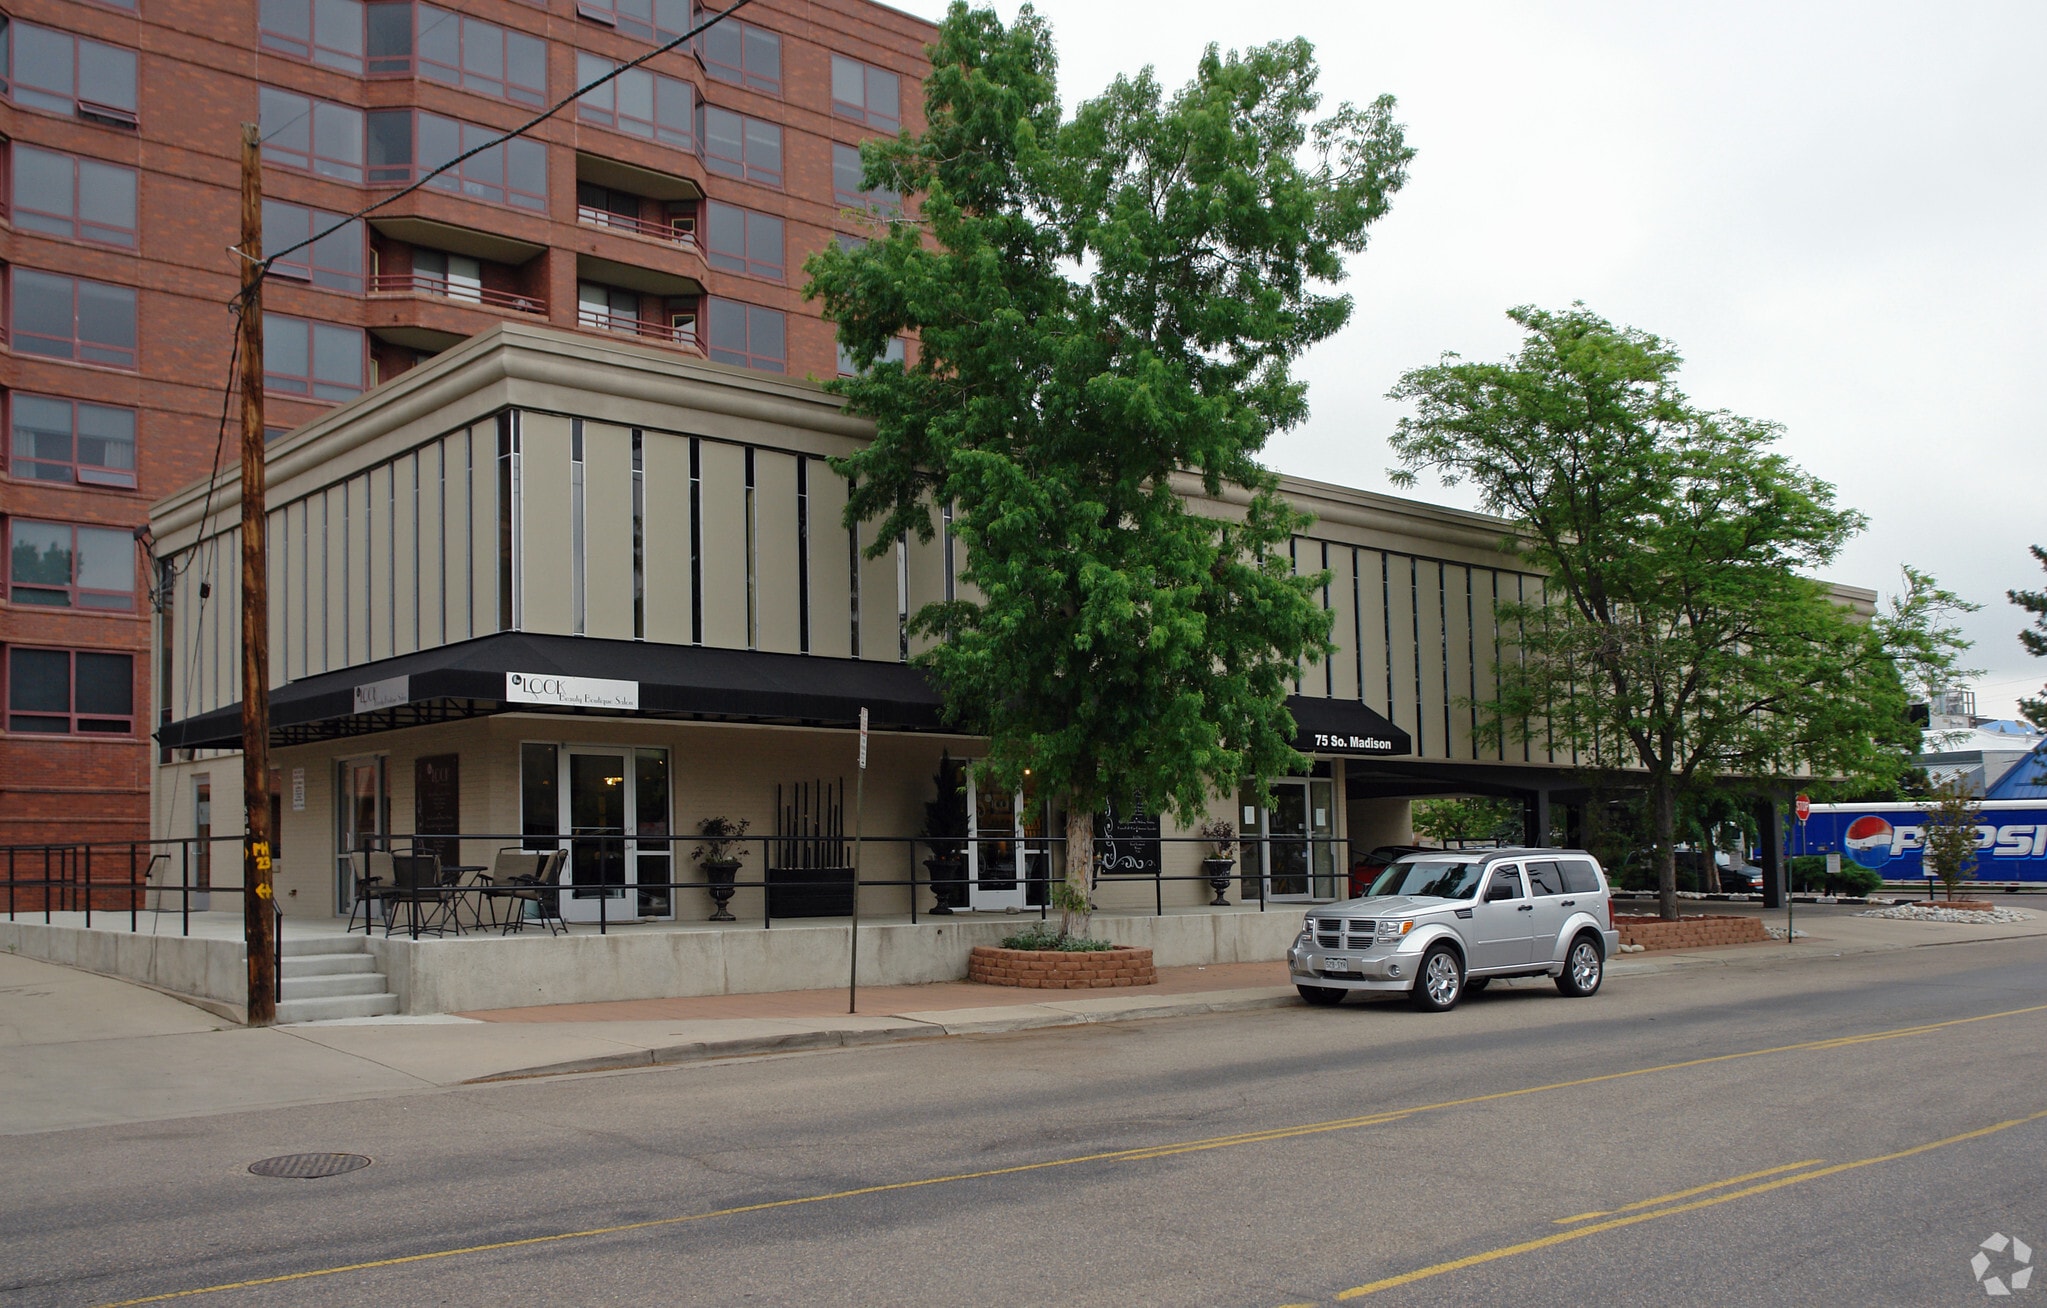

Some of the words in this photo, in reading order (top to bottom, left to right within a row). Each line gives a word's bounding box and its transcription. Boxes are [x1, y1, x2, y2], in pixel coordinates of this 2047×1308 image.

[523, 677, 566, 699] LOOK
[615, 696, 634, 706] Salon
[1314, 734, 1328, 746] 75
[1331, 735, 1347, 748] So.
[1350, 736, 1392, 750] Madison
[1796, 800, 1809, 812] STOP
[256, 856, 271, 870] 23
